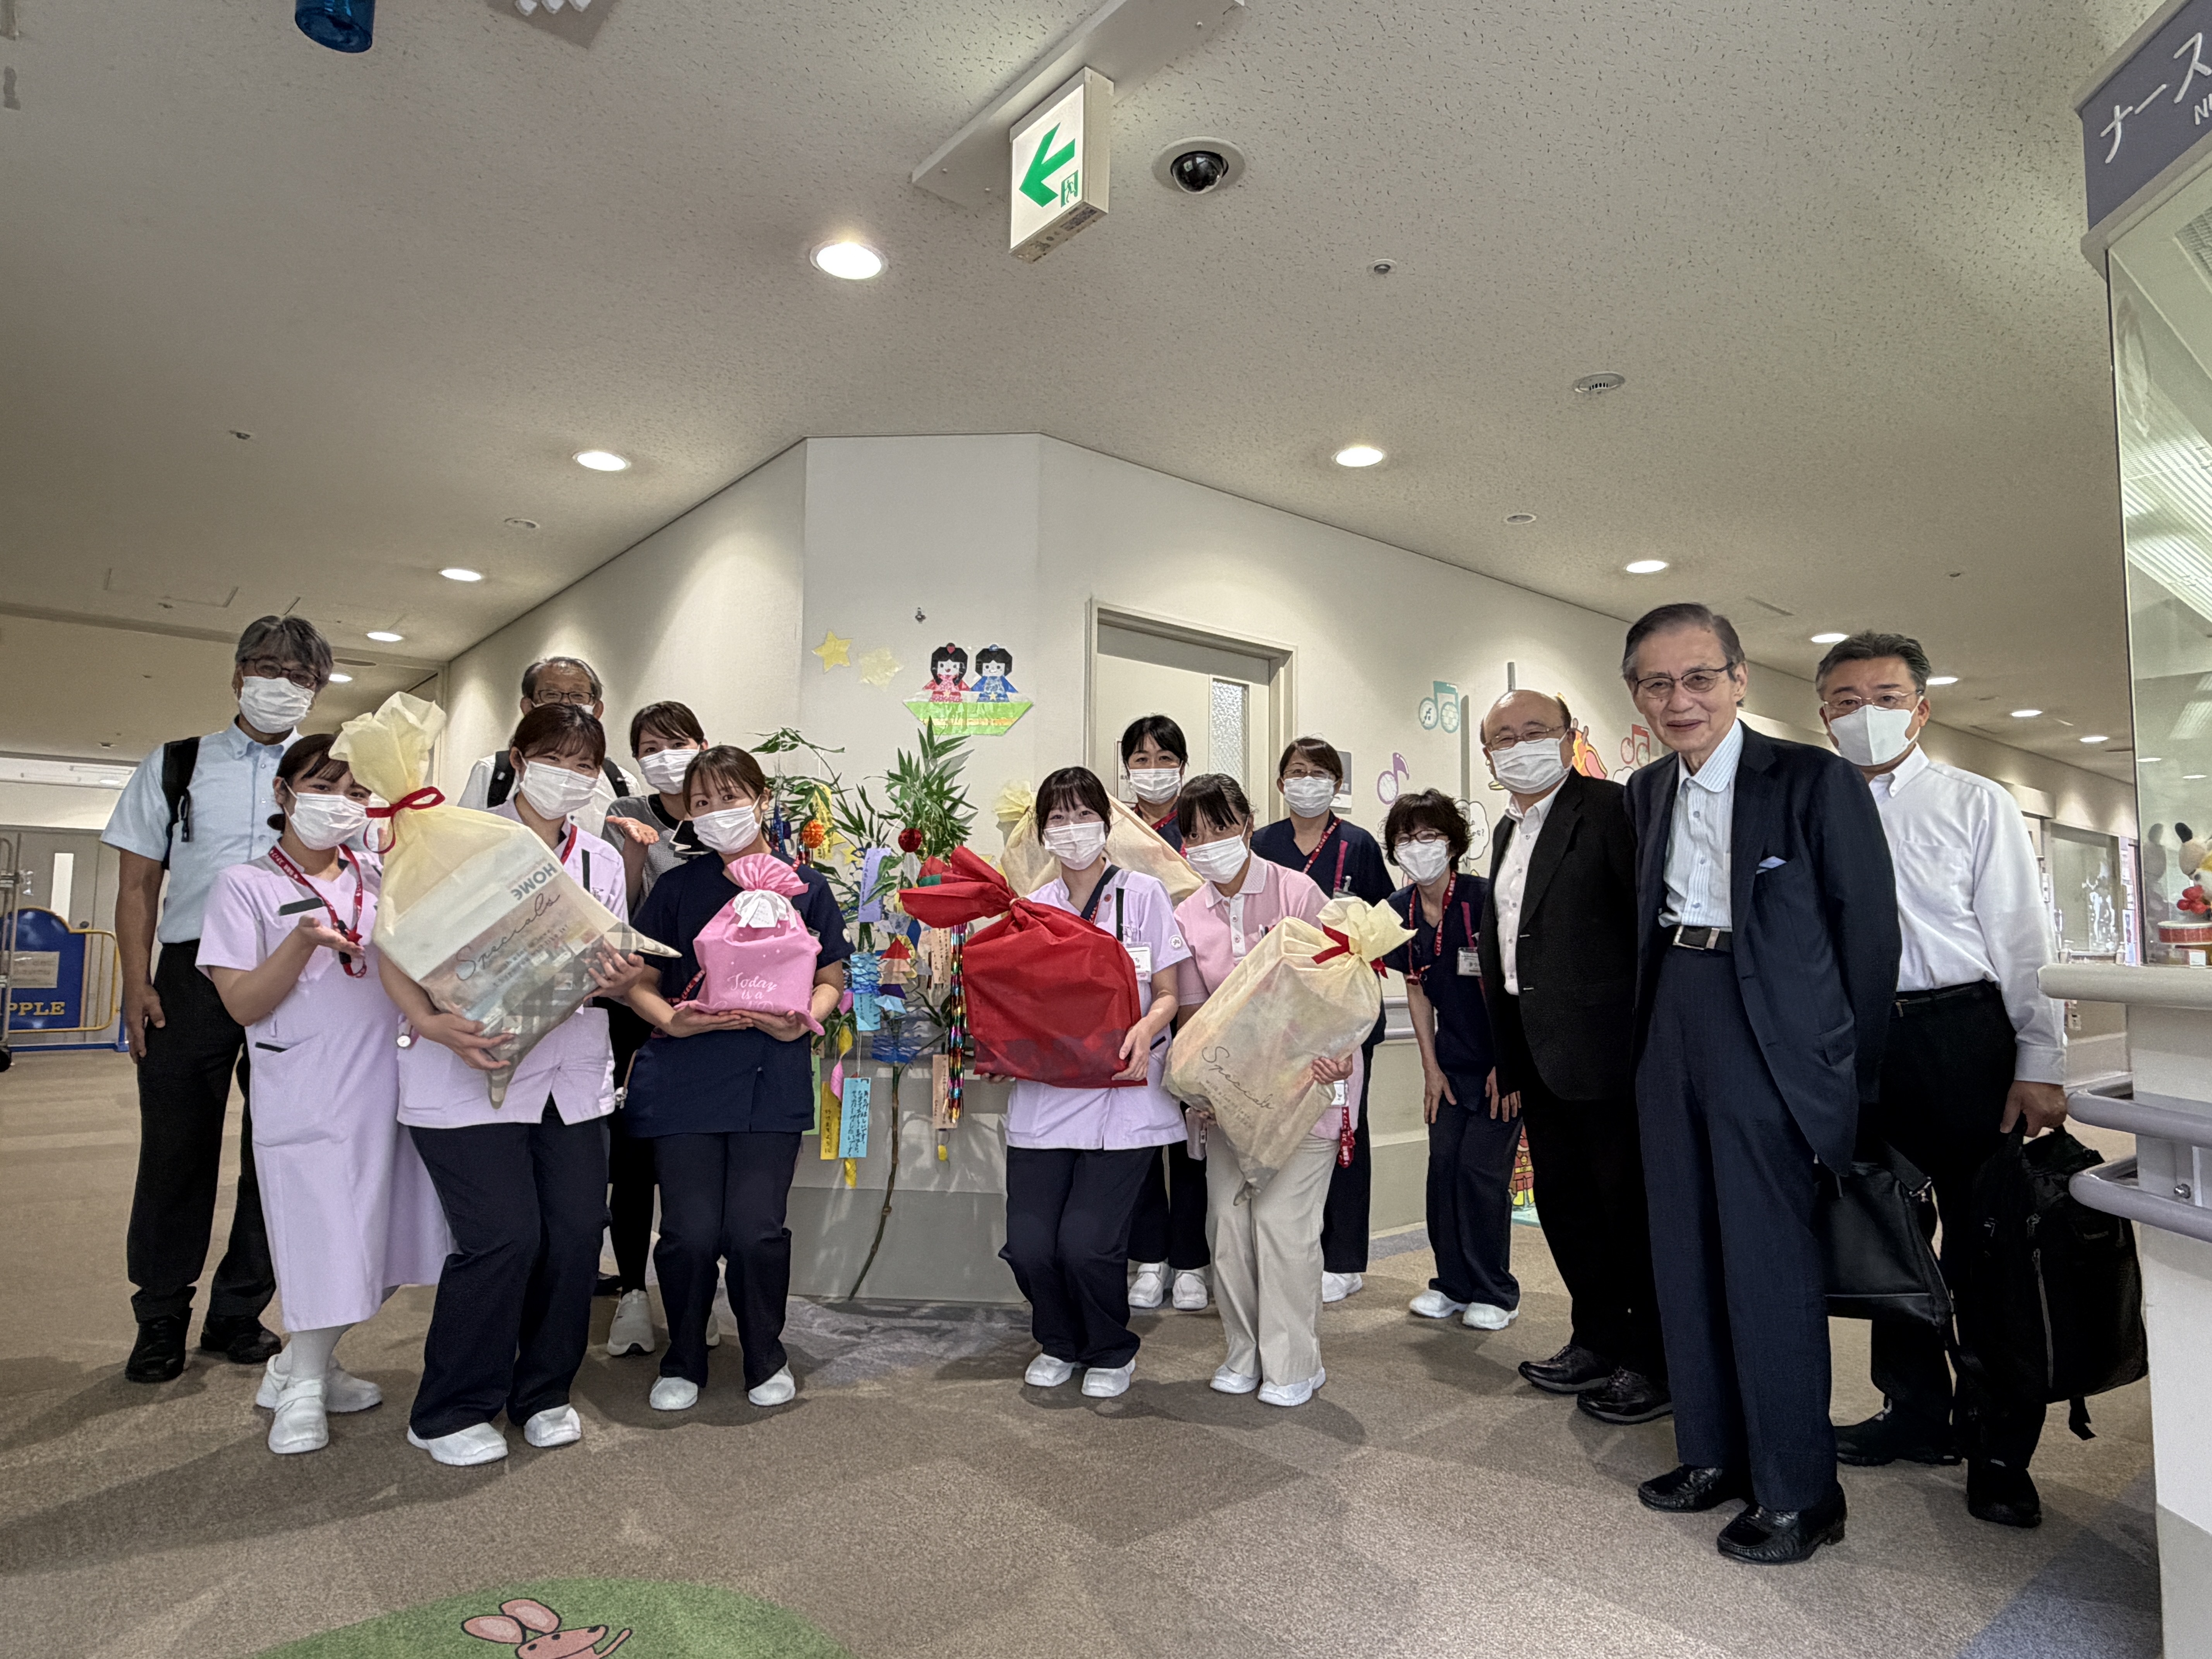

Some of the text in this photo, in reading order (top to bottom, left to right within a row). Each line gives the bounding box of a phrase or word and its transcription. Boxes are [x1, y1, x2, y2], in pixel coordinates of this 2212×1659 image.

[2100, 32, 2212, 164] ナース
[510, 862, 558, 901] HOME
[456, 893, 560, 981] Specials
[727, 972, 778, 992] Today
[741, 989, 752, 1000] is
